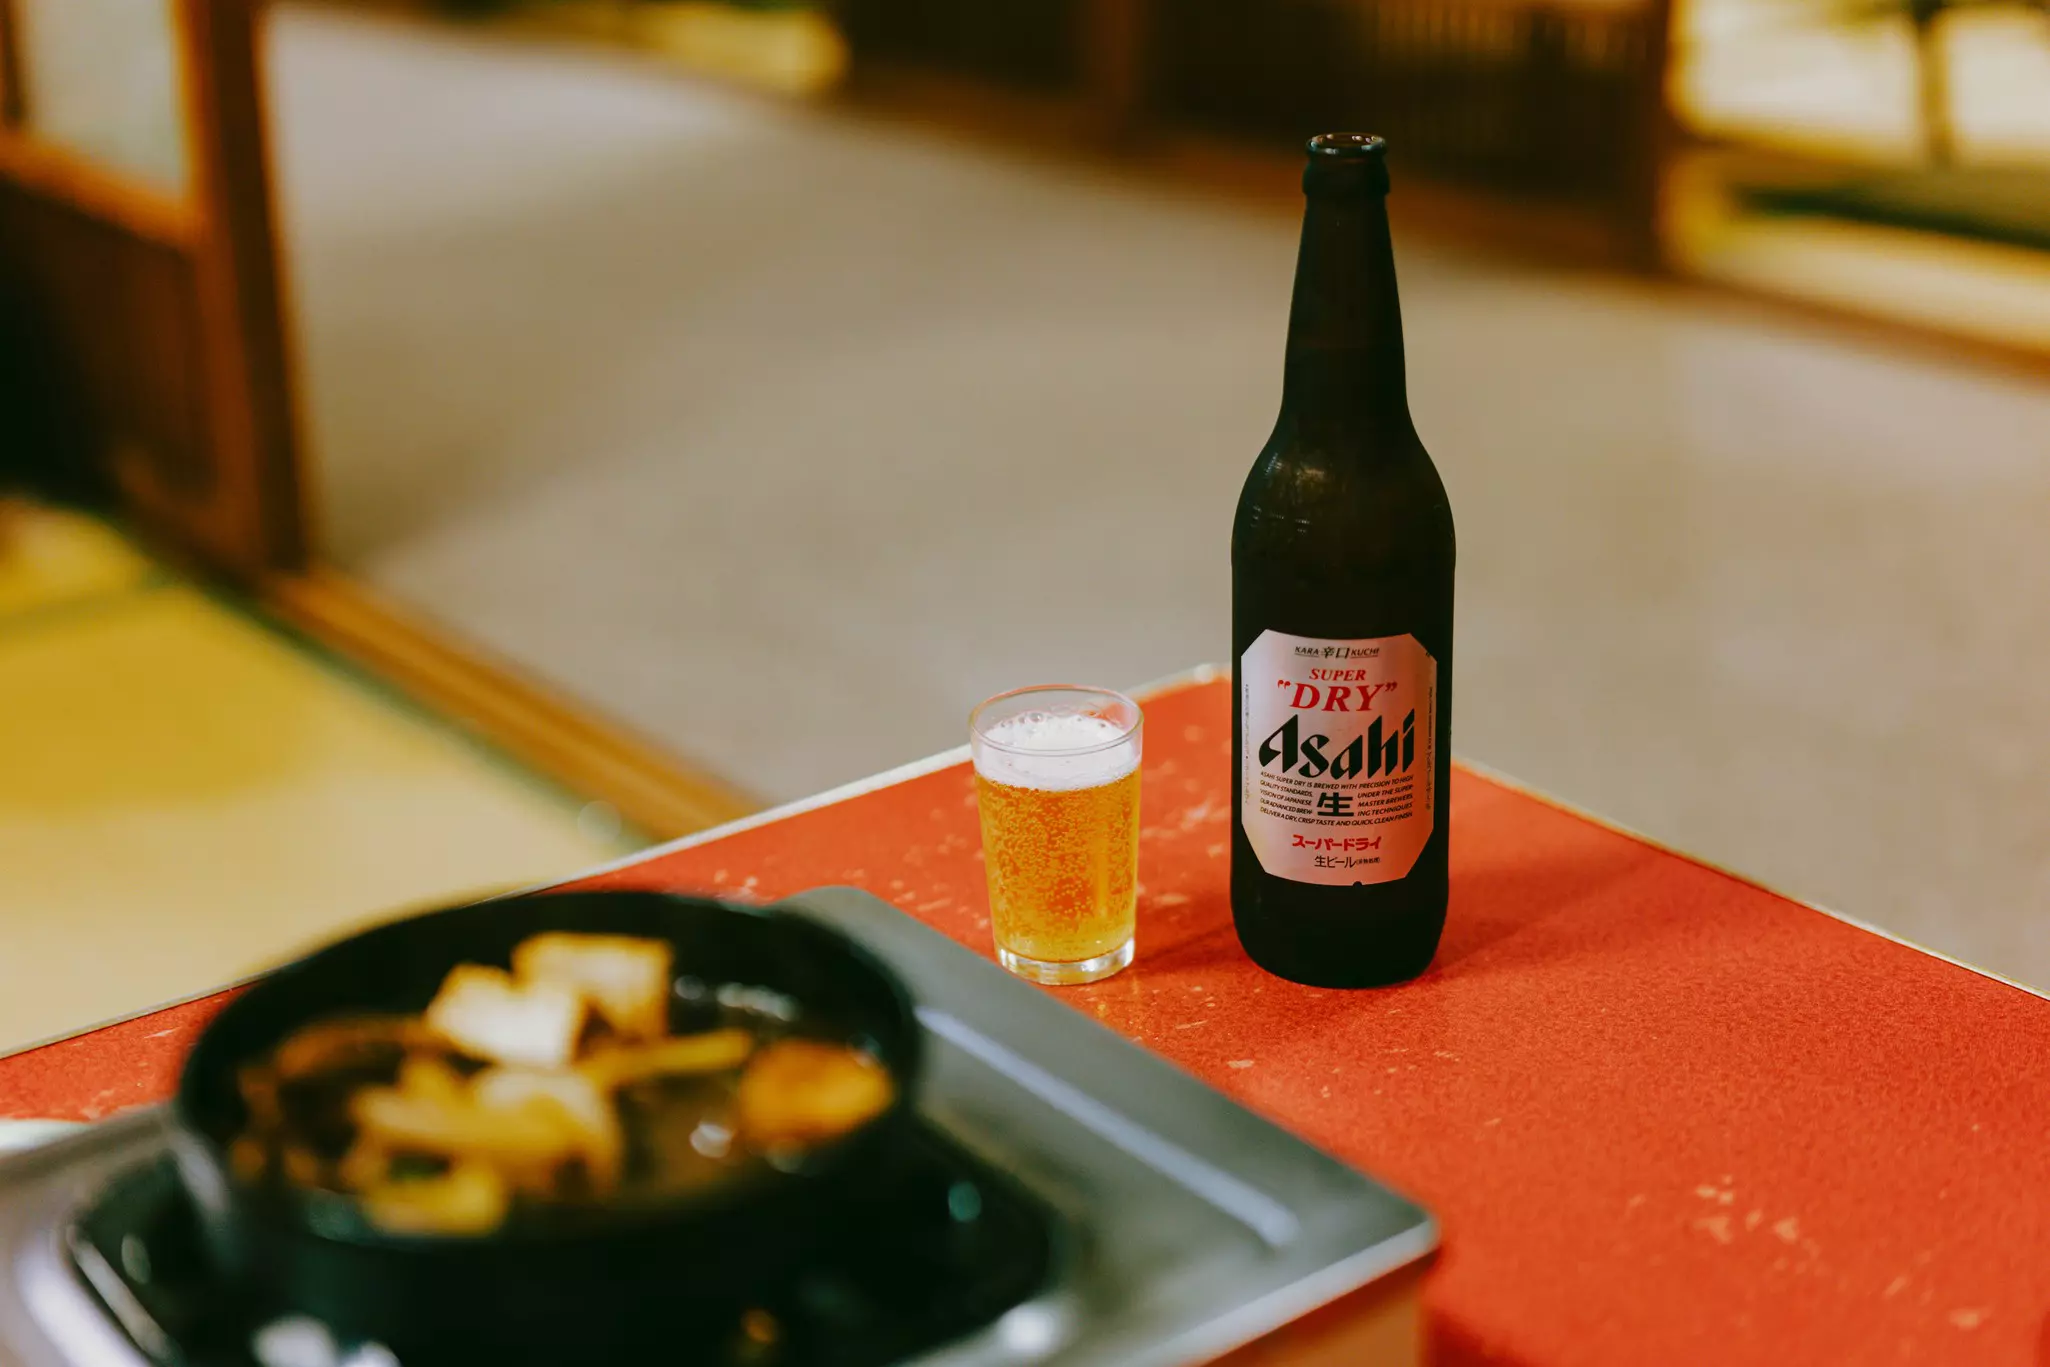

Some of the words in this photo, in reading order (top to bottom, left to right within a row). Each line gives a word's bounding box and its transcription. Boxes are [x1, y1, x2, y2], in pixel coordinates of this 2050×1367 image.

[1295, 646, 1319, 656] KARA
[1351, 647, 1379, 656] KUCHI
[1309, 668, 1366, 681] SUPER
[1259, 708, 1415, 780] Asahi
[1260, 779, 1280, 790] QUALITY
[1261, 771, 1275, 779] ASAHI
[1276, 775, 1293, 784] SUPER
[1314, 782, 1340, 790] BREWED
[1359, 781, 1390, 789] PRECISION
[1260, 789, 1277, 799] VISION
[1284, 796, 1312, 805] JAPANESE
[1317, 792, 1354, 816] 生
[1358, 799, 1384, 807] MASTER
[1270, 802, 1296, 812] ADVANCED
[1372, 804, 1413, 814] TECHNIQUES
[1260, 807, 1280, 817] DELIVER
[1374, 815, 1394, 824] CLEAN
[1292, 834, 1382, 851] スーパードライ
